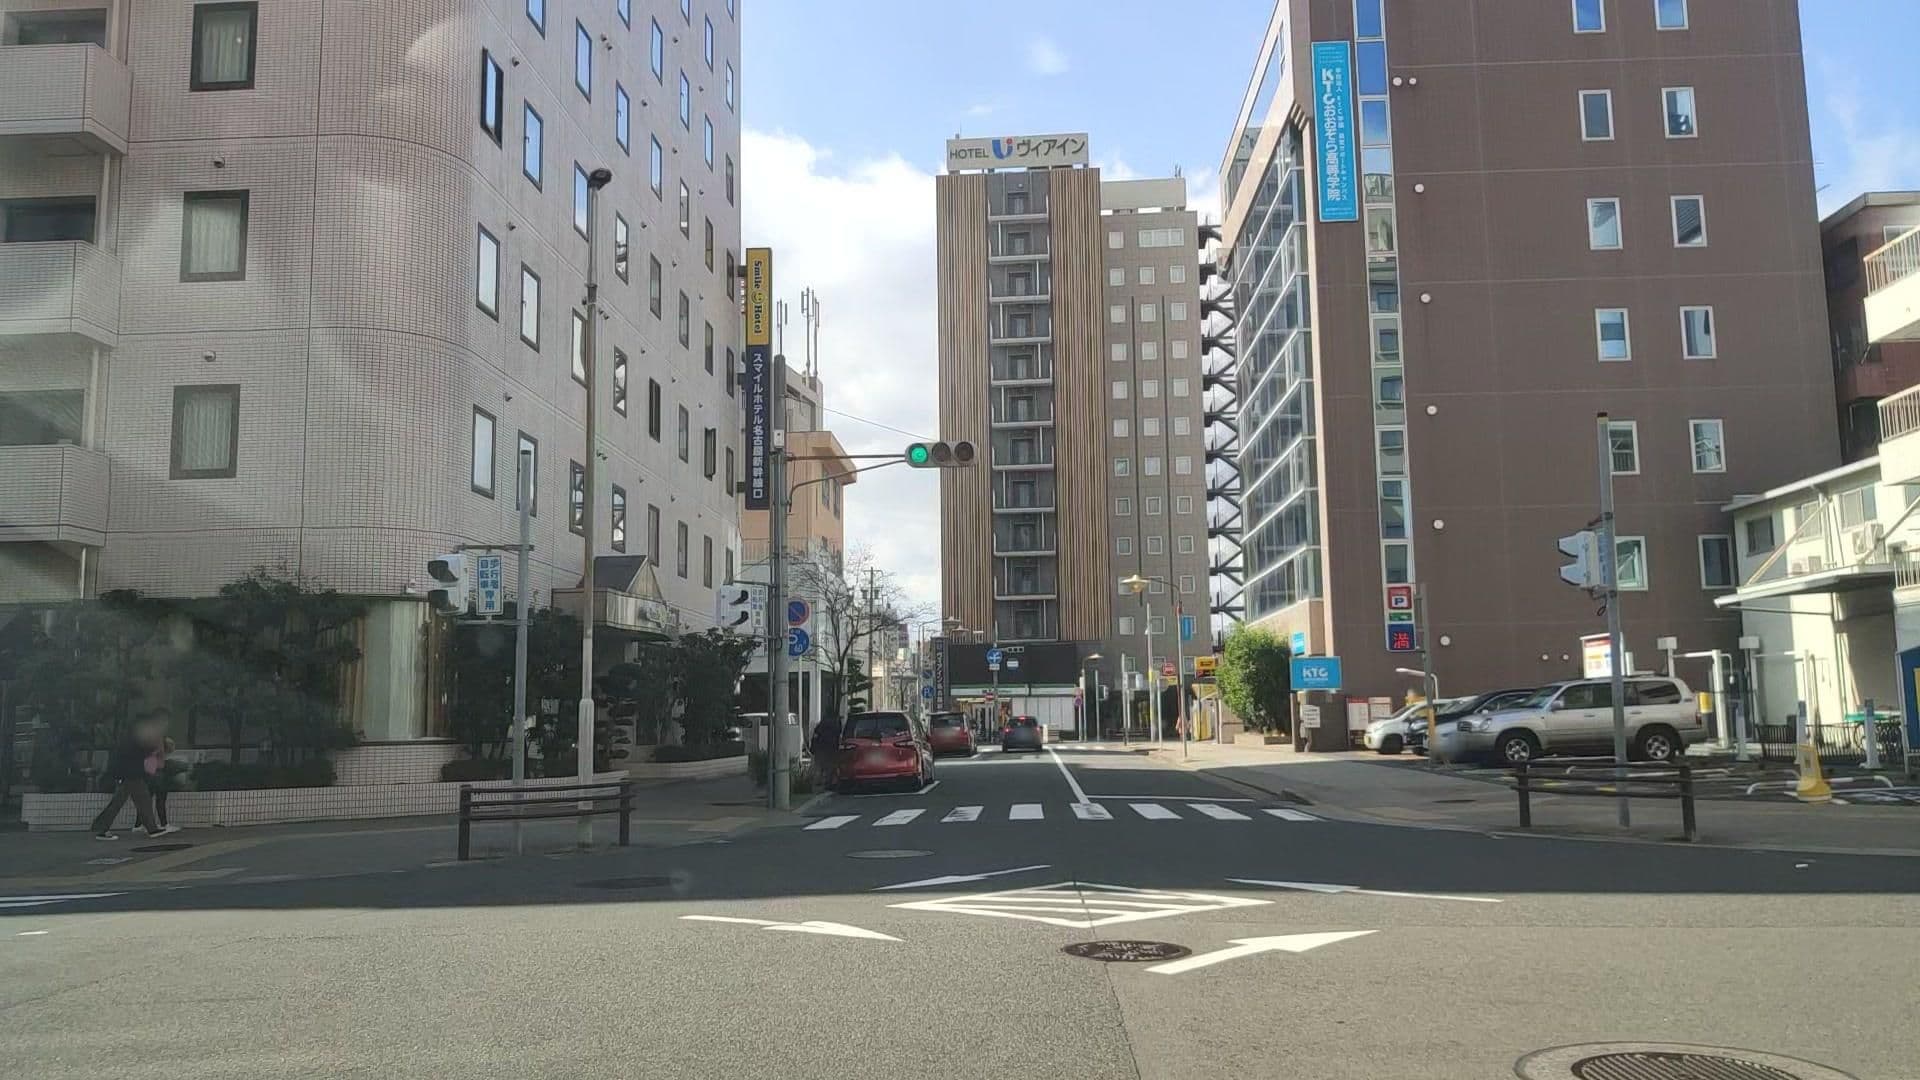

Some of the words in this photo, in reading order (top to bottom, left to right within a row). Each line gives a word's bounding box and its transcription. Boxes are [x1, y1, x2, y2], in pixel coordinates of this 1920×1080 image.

[951, 148, 989, 159] HOTEL
[1017, 138, 1085, 157] ヴィアイン
[754, 260, 763, 289] Smile
[754, 305, 763, 334] Hotel
[753, 353, 763, 499] スマイルホテル名古屋新幹線口
[1394, 597, 1404, 606] P
[1393, 633, 1409, 648] 満
[1303, 667, 1328, 678] KTC
